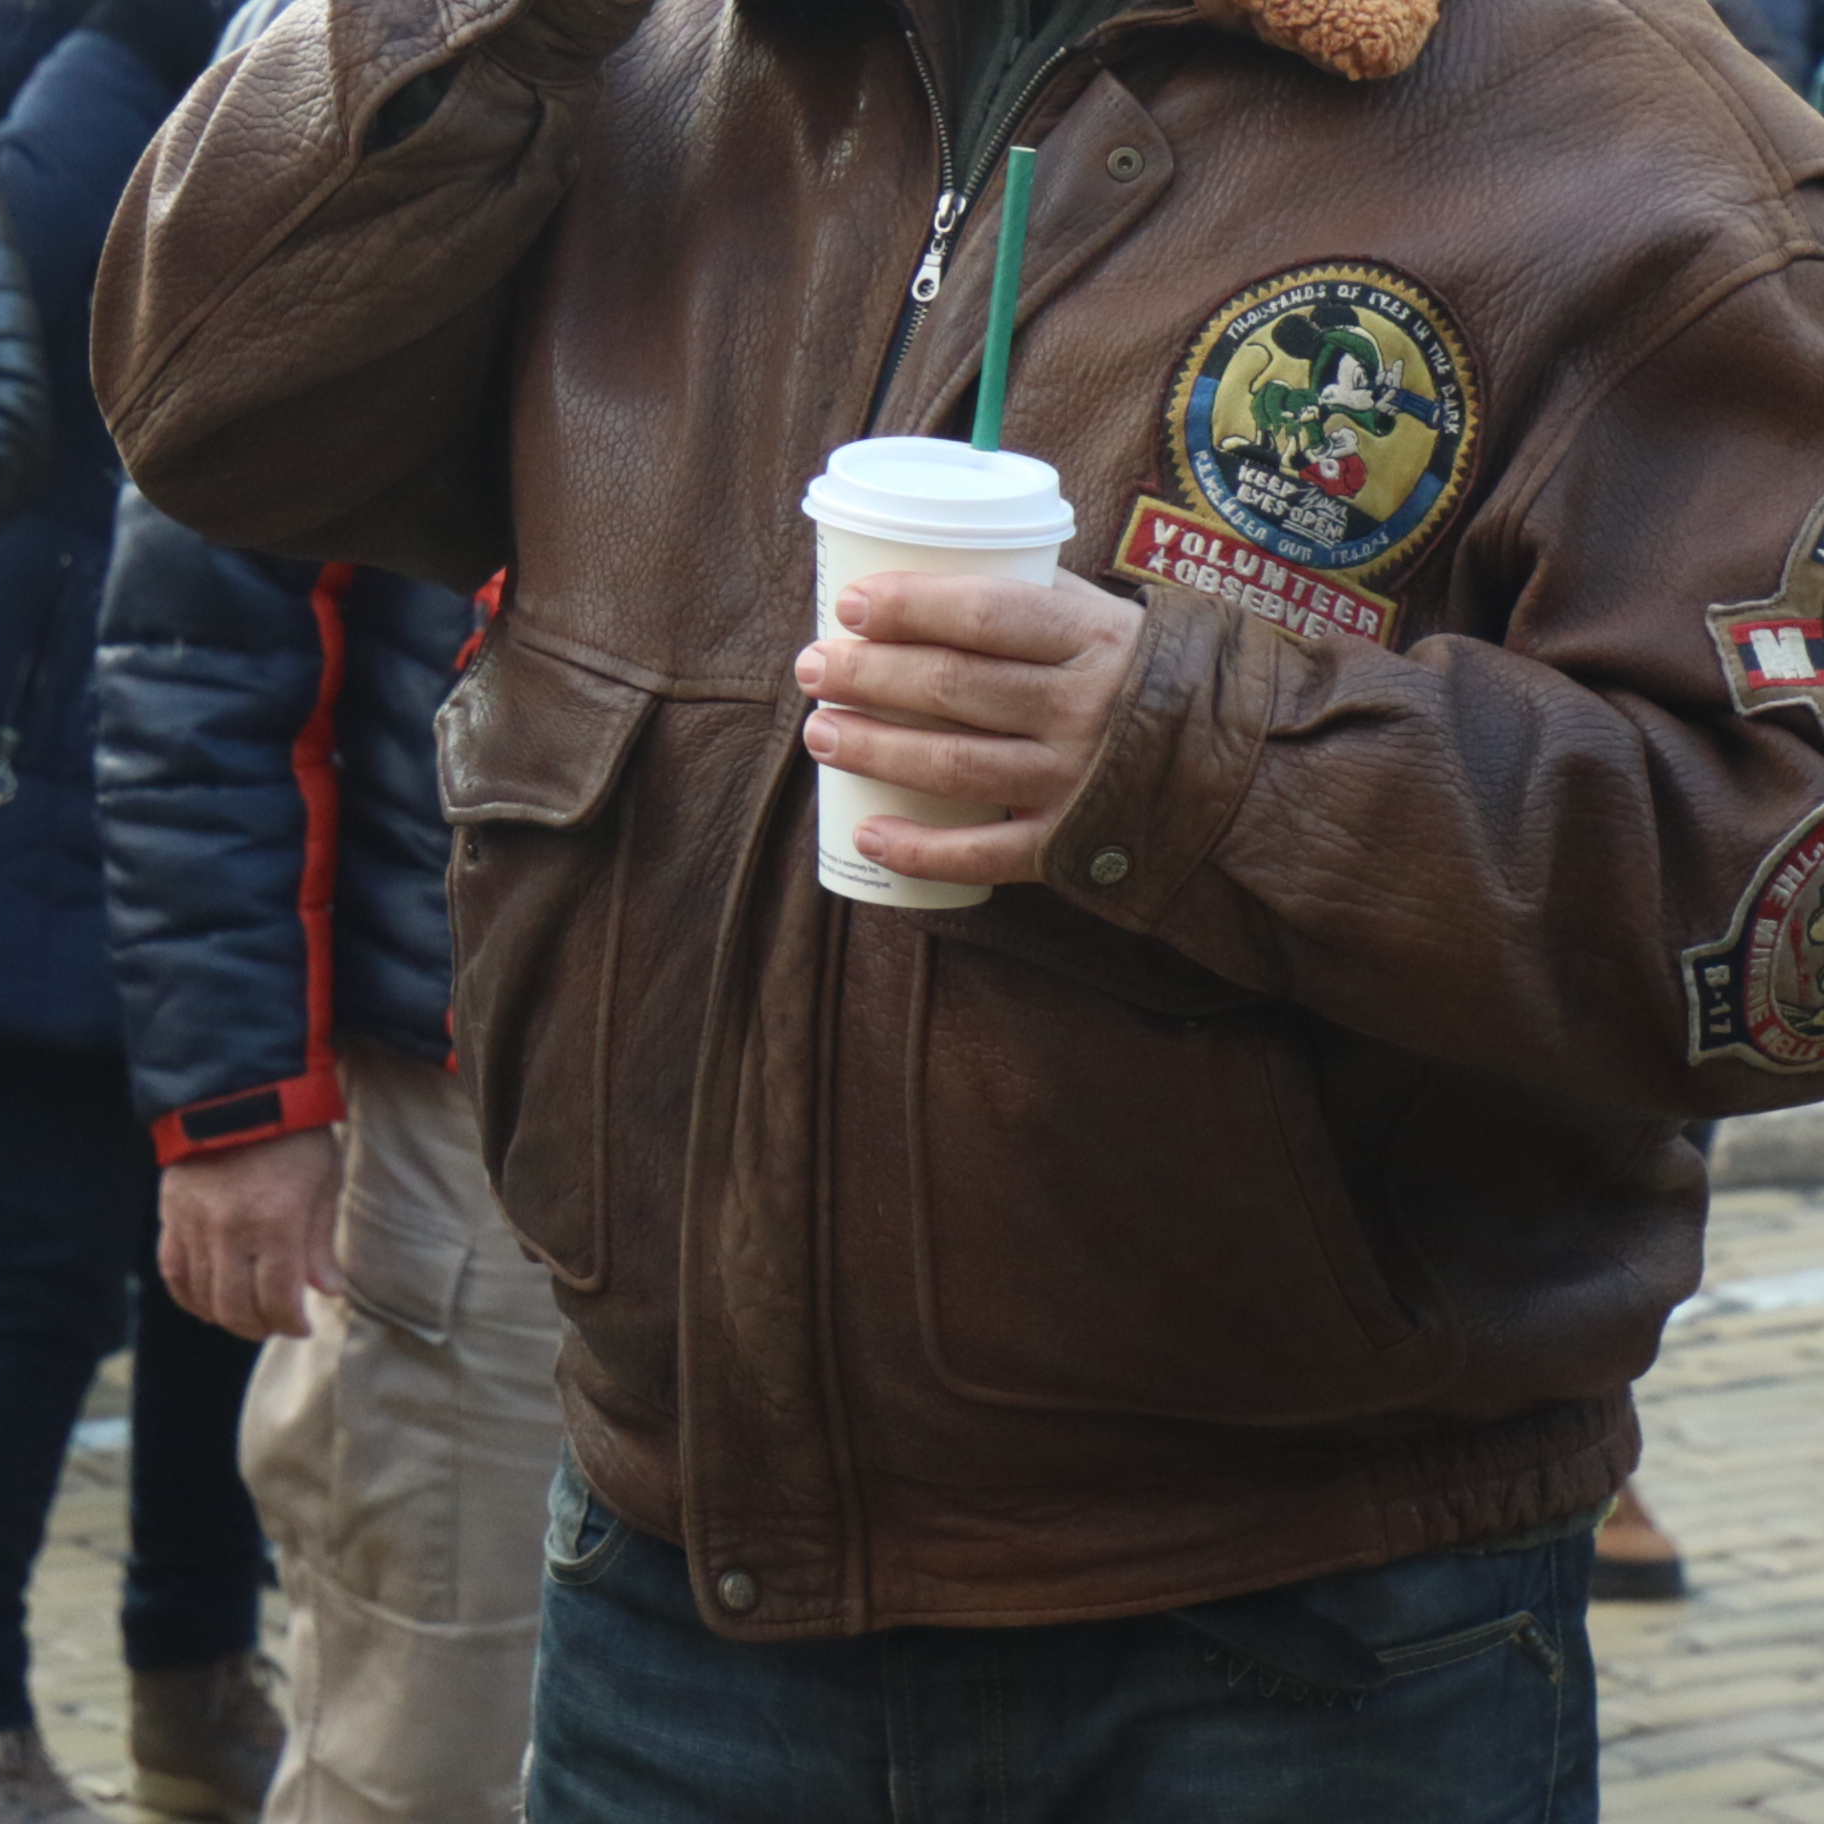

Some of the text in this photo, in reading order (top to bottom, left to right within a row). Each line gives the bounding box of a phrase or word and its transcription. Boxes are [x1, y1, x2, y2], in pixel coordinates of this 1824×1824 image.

[1226, 284, 1326, 341] THOUSANDS
[1337, 284, 1361, 300] OF
[1413, 320, 1431, 340] IN
[1428, 341, 1452, 375] THE
[1441, 383, 1460, 435] DARK
[1237, 483, 1291, 516] EYES
[1238, 463, 1299, 499] KEEP
[1154, 518, 1380, 636] VOLUNTEER
[1749, 626, 1817, 680] M
[1704, 965, 1732, 1034] B-17
